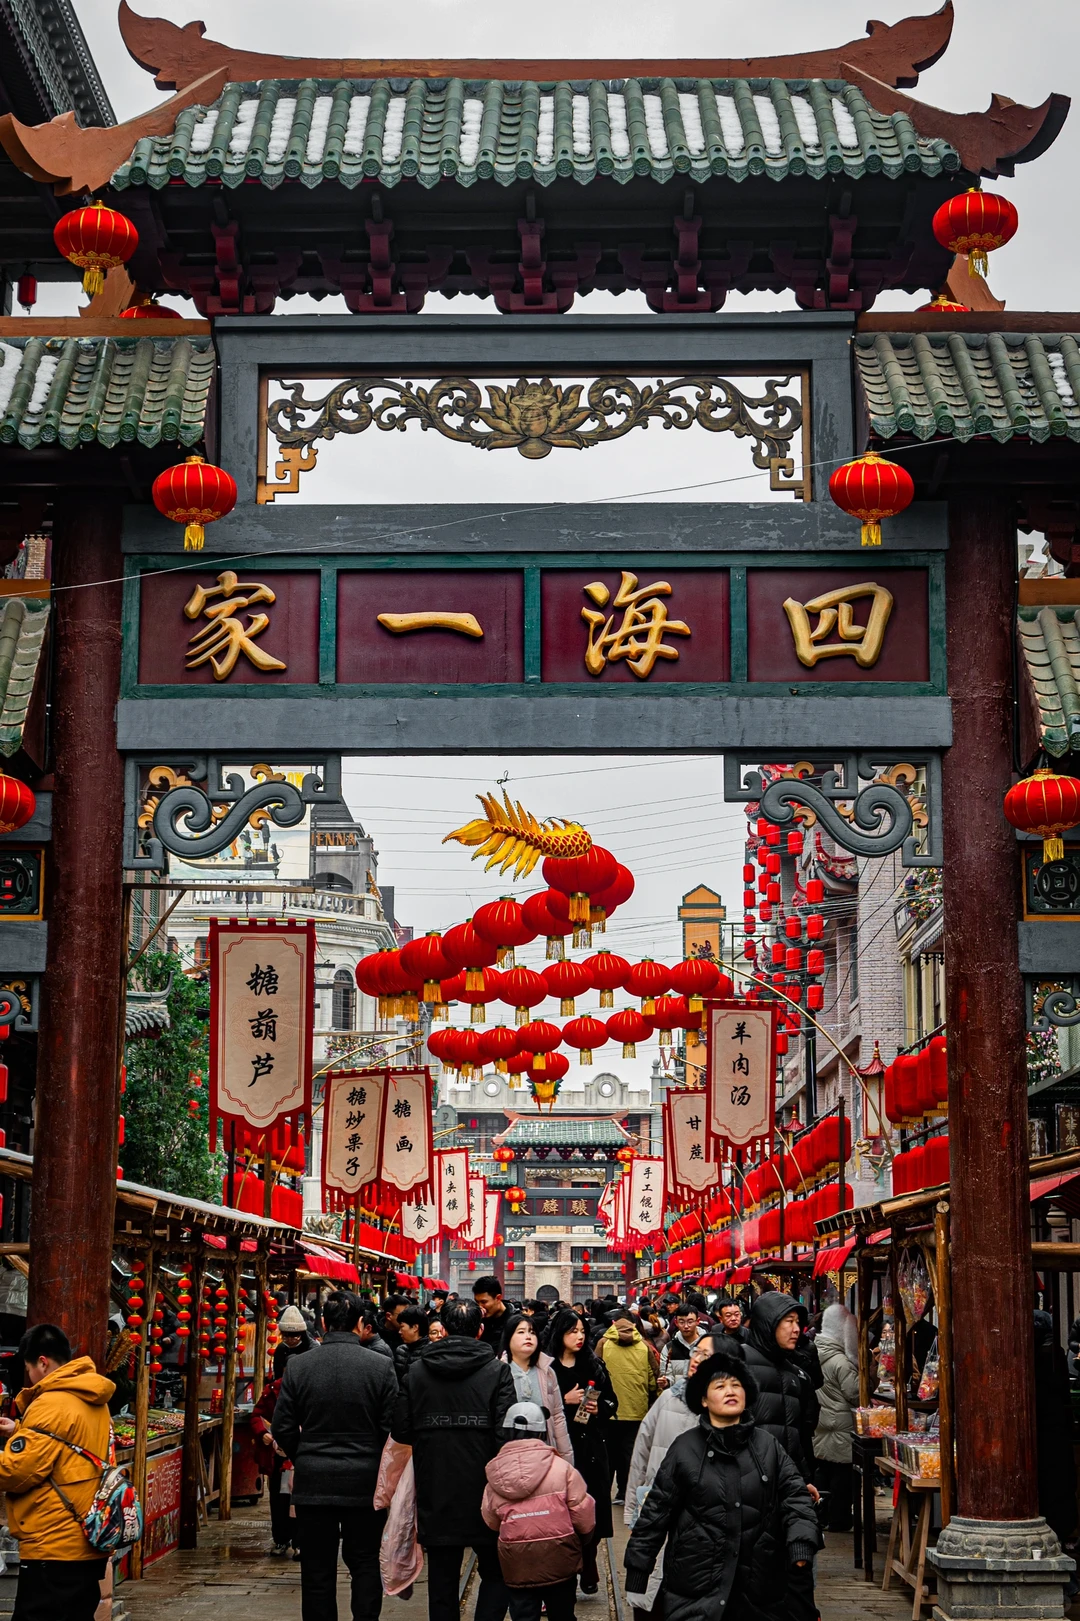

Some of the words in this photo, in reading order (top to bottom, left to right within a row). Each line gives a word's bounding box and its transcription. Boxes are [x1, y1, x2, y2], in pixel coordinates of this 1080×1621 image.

[245, 963, 280, 1088] 糖葫芦
[730, 1021, 752, 1107] 羊肉汤
[345, 1086, 368, 1177] 糖炒栗子
[392, 1098, 413, 1153] 糖画
[685, 1115, 704, 1161] 甘蔗
[445, 1163, 459, 1211] 肉夹馍
[638, 1166, 654, 1223] 手工馄饨
[423, 1415, 488, 1426] EXPLORE
